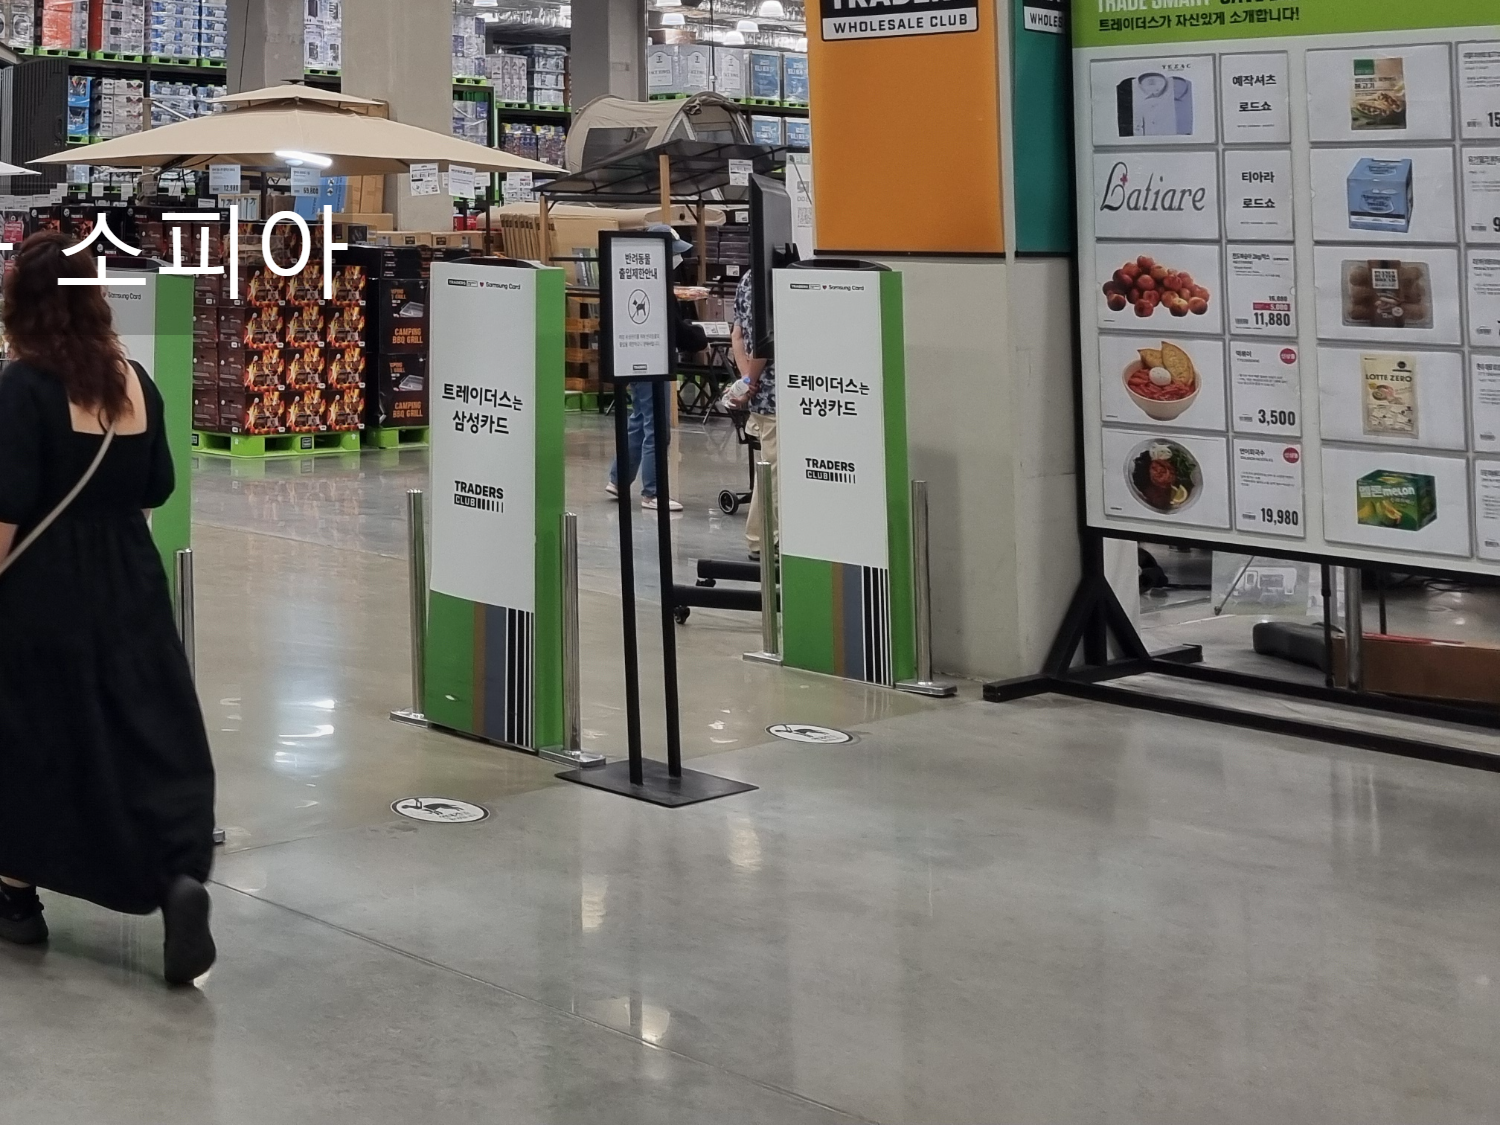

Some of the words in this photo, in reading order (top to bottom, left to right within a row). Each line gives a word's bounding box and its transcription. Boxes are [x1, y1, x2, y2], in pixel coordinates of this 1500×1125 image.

[833, 17, 925, 34] WHOLESALE
[929, 13, 968, 28] CLUB
[1098, 16, 1172, 32] 트레이더스가
[1175, 11, 1225, 28] 자신있게
[1229, 7, 1300, 24] 소개합니다!
[1232, 74, 1277, 86] 예작셔츠
[1238, 101, 1272, 113] 로드쇼
[1241, 171, 1275, 184] 티아라
[1242, 198, 1276, 209] 로드쇼
[624, 253, 651, 265] 반려동물
[618, 267, 658, 280] 출입제한안내
[486, 281, 508, 290] Samsung
[107, 291, 129, 300] Samsung
[129, 292, 142, 300] Card
[1253, 312, 1290, 327] 11,880
[394, 327, 422, 336] CAMPING
[392, 336, 405, 344] BBQ
[406, 335, 423, 344] GRILL
[787, 374, 870, 395] 트레이더스는
[1390, 374, 1412, 383] ZERO
[442, 382, 524, 412] 트레이더스는
[394, 401, 422, 410] CAMPING
[799, 397, 858, 417] 삼성카드
[392, 410, 406, 418] BBQ
[406, 409, 423, 418] GRILL
[1257, 409, 1296, 426] 3,500
[452, 409, 510, 435] 삼성카드
[805, 457, 855, 472] TRADERS
[806, 470, 829, 481] CLUB
[454, 480, 504, 500] TRADERS
[1358, 485, 1383, 498] 멜론
[1383, 486, 1415, 497] melon
[455, 494, 476, 507] CLUB
[1260, 507, 1299, 525] 19,980
